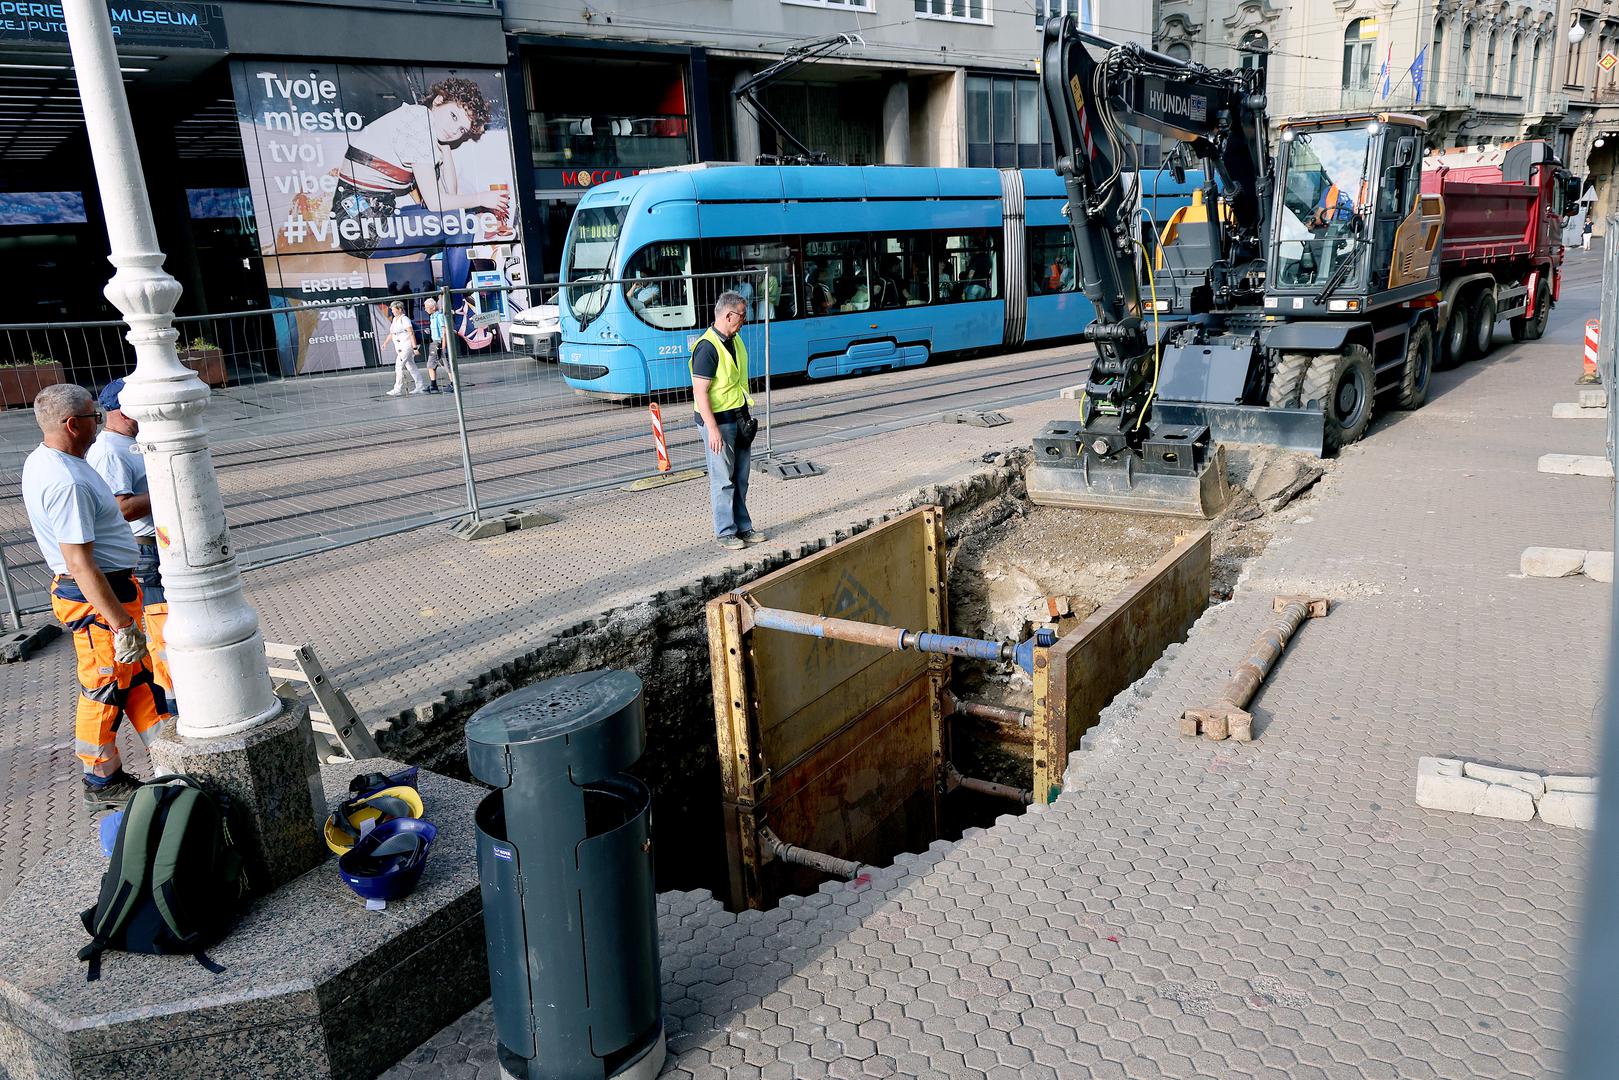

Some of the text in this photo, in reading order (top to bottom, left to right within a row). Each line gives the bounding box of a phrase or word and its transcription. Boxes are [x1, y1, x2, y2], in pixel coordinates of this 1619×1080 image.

[0, 1, 198, 26] PERIE MUSEUM
[257, 72, 337, 105] Tvoje
[1150, 90, 1190, 117] HYUNDAI
[264, 105, 364, 137] mjesto
[269, 138, 324, 168] tvoj
[274, 172, 336, 194] vibe
[284, 210, 499, 248] #vjerujusebe
[301, 276, 348, 293] ERSTE
[320, 308, 357, 321] ZONA
[308, 330, 375, 345] erstebank.hr
[658, 345, 683, 355] 2221
